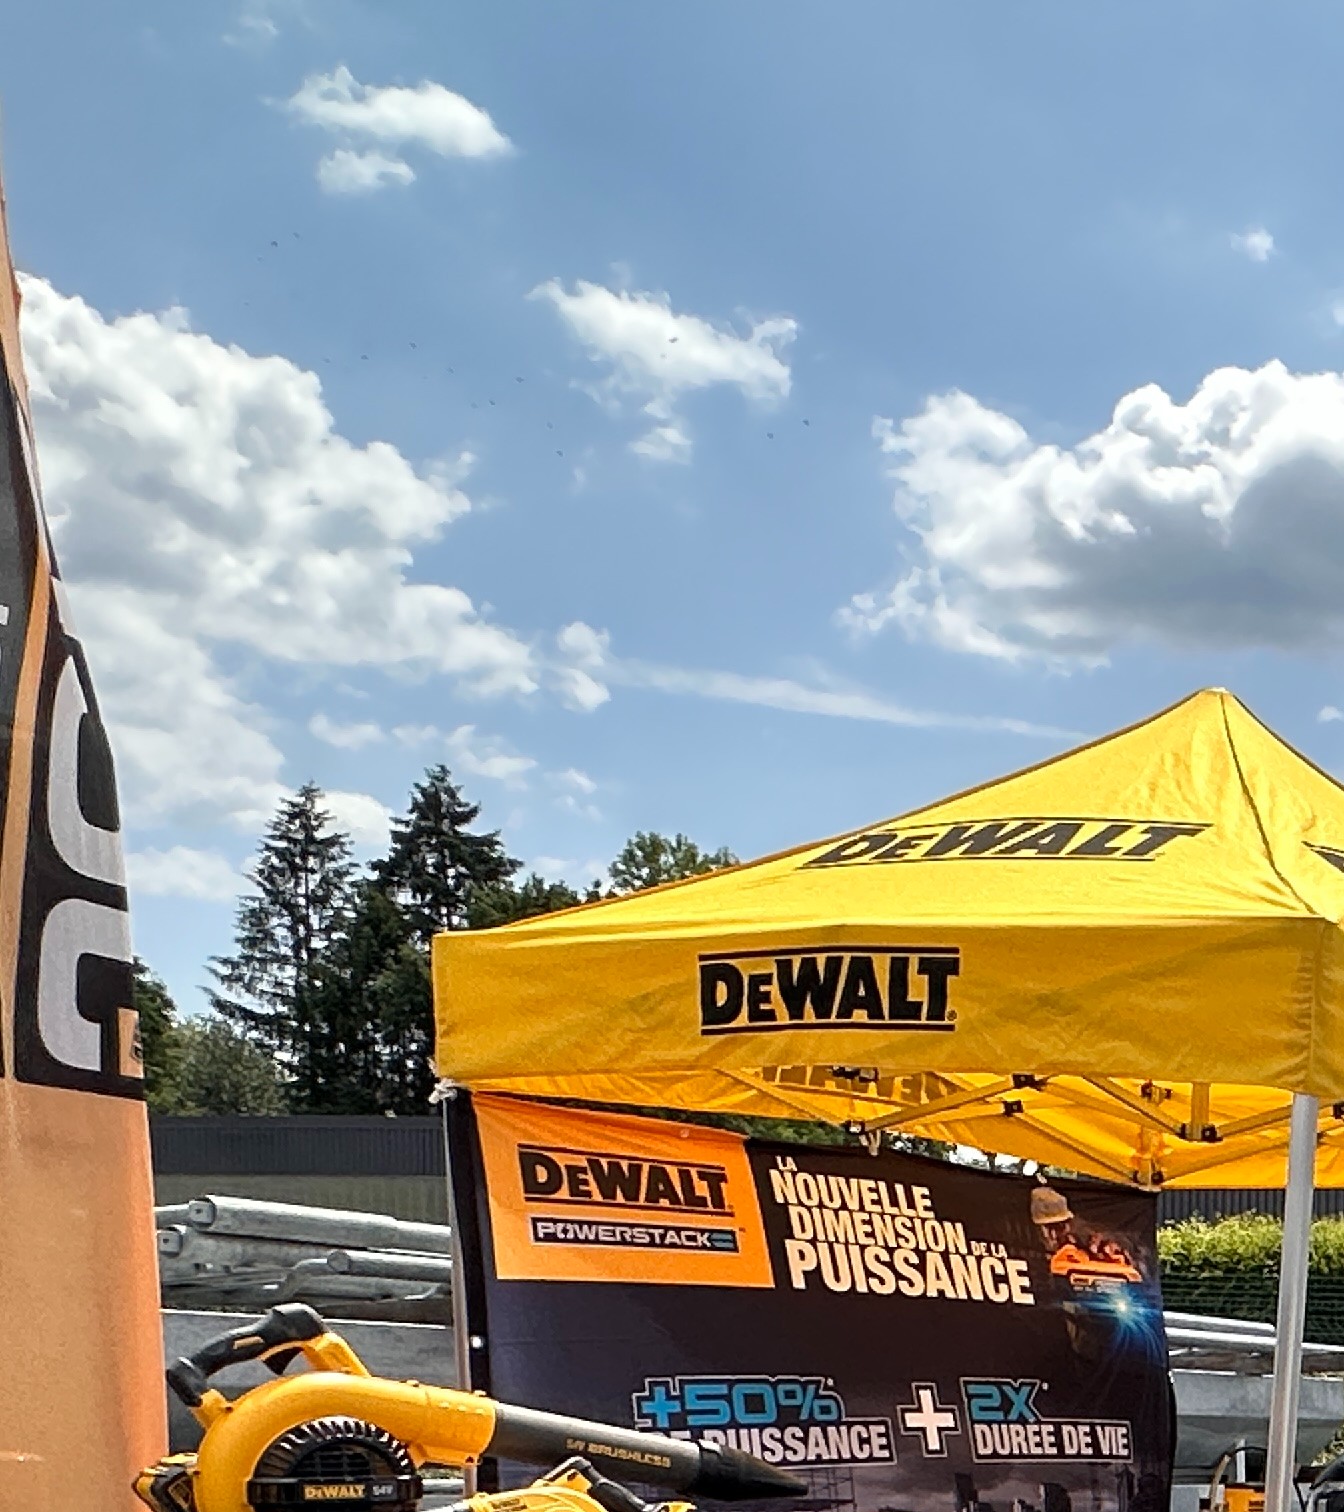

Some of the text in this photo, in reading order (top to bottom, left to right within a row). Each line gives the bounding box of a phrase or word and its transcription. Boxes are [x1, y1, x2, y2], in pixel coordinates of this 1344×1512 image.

[810, 818, 1206, 866] DEWALT
[700, 953, 959, 1026] DEWALT
[517, 1149, 729, 1210] DEWALT
[776, 1156, 797, 1172] LA
[769, 1168, 936, 1220] NOUVELLE
[537, 1222, 711, 1248] POWERSTACK
[789, 1204, 1007, 1259] DIMENSION DE LA
[784, 1239, 1036, 1306] PUISSANCE
[976, 1419, 1130, 1458] DURÉE DE VIE
[304, 1484, 366, 1499] DEWALT
